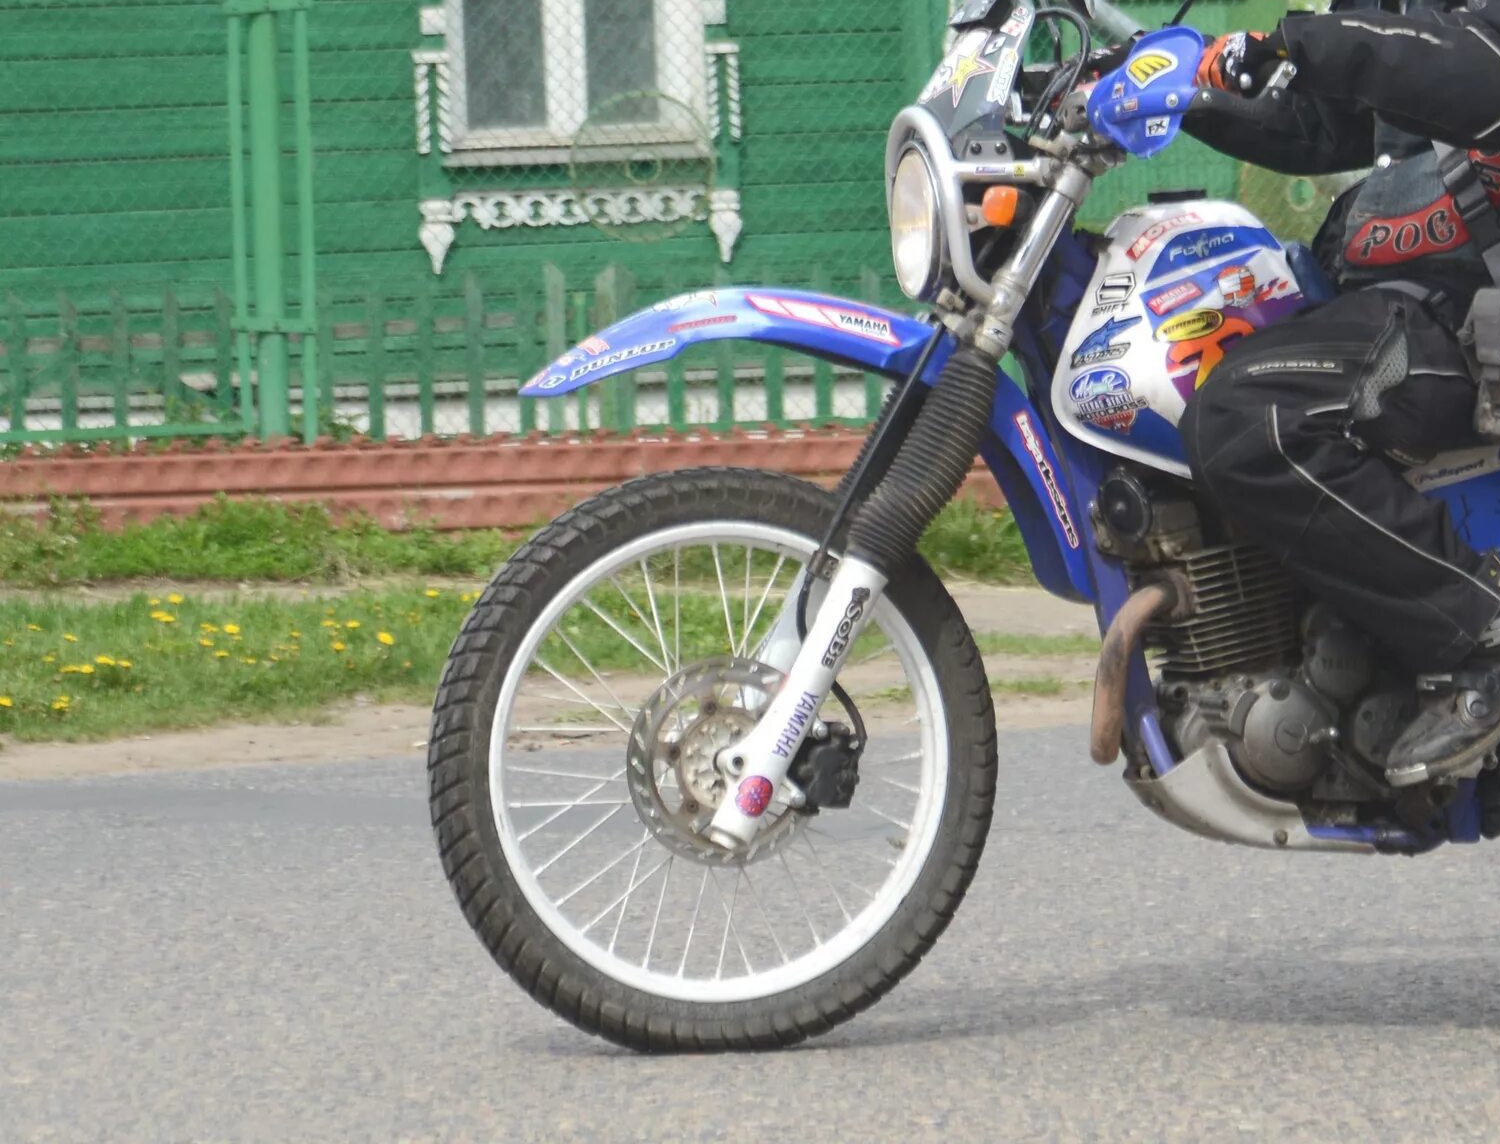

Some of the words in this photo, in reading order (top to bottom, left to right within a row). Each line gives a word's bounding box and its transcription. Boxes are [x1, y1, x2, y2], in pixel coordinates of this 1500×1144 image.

[839, 313, 889, 333] YAMAHA
[1091, 302, 1130, 316] SHIFT
[571, 340, 675, 379] DUNLOP
[772, 690, 819, 758] YAMAHA
